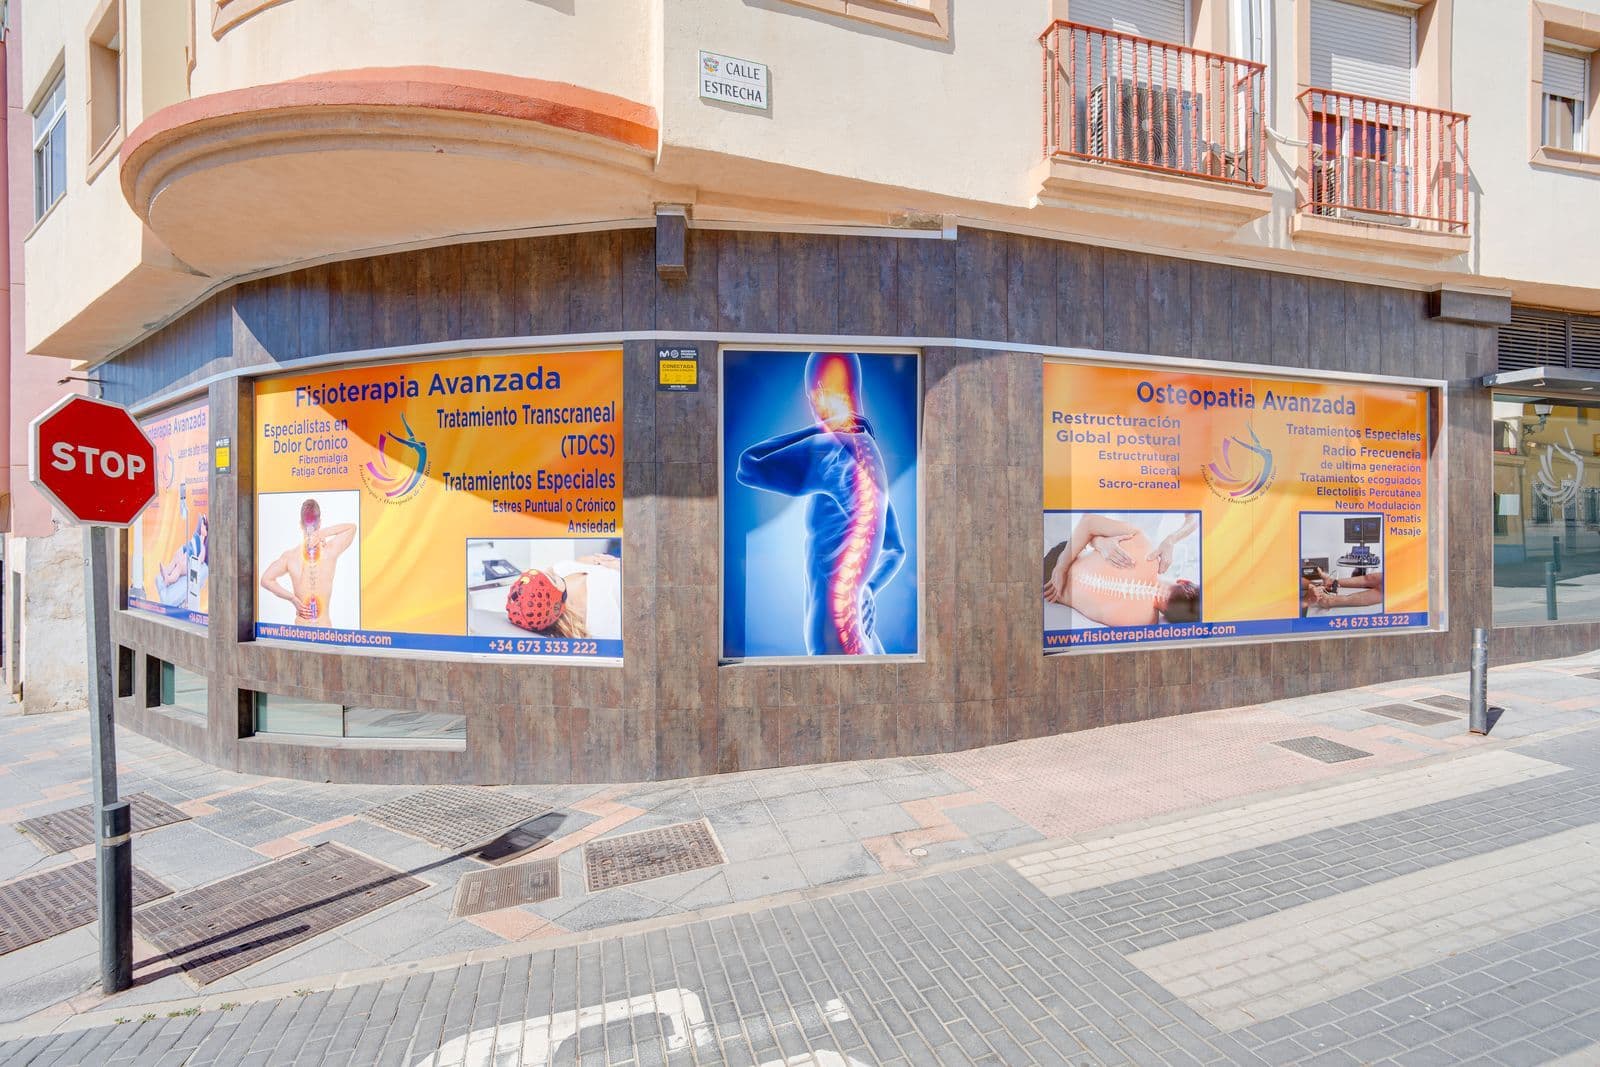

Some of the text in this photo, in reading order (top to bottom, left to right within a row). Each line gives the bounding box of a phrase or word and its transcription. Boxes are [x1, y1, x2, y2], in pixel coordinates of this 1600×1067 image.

[725, 62, 760, 80] CALLE
[704, 80, 762, 102] ESTRECHA
[296, 366, 561, 407] Fisioterapia Avanzada
[1136, 381, 1356, 415] Osteopatia Avanzada
[437, 401, 615, 429] Tratamiento Transcraneal
[1052, 411, 1180, 428] Restructuración
[264, 418, 348, 439] Especialistas en
[1286, 423, 1421, 442] Tratamientos Especiales
[273, 434, 348, 454] Dolor Crónico
[561, 434, 615, 458] (TDCS)
[1056, 429, 1180, 447] Global postural
[1098, 450, 1180, 462] Estructrutural
[1323, 444, 1421, 459] Radio Frecuencia
[51, 441, 146, 481] STOP
[1320, 460, 1333, 470] de
[1336, 460, 1366, 471] ultima
[292, 466, 315, 477] Fatiga
[1140, 465, 1180, 476] Biceral
[1300, 472, 1365, 484] Tratamientos
[443, 468, 616, 493] Tratamientos Especiales
[1098, 478, 1180, 489] Sacro-craneal
[1317, 486, 1366, 497] Electolisis
[492, 497, 616, 513] Estres Puntual o Crónico
[1335, 500, 1364, 509] Neuro
[567, 518, 616, 534] Ansiedad
[1386, 513, 1421, 523] Tomatis
[1390, 526, 1421, 537] Masaje
[1328, 614, 1410, 629] +34 673 333 222
[259, 625, 392, 646] www.fisioterapiadelosrios.com
[1046, 624, 1236, 645] www.fisioterapiadelosrios.com
[489, 639, 598, 655] +34 673 333 222
